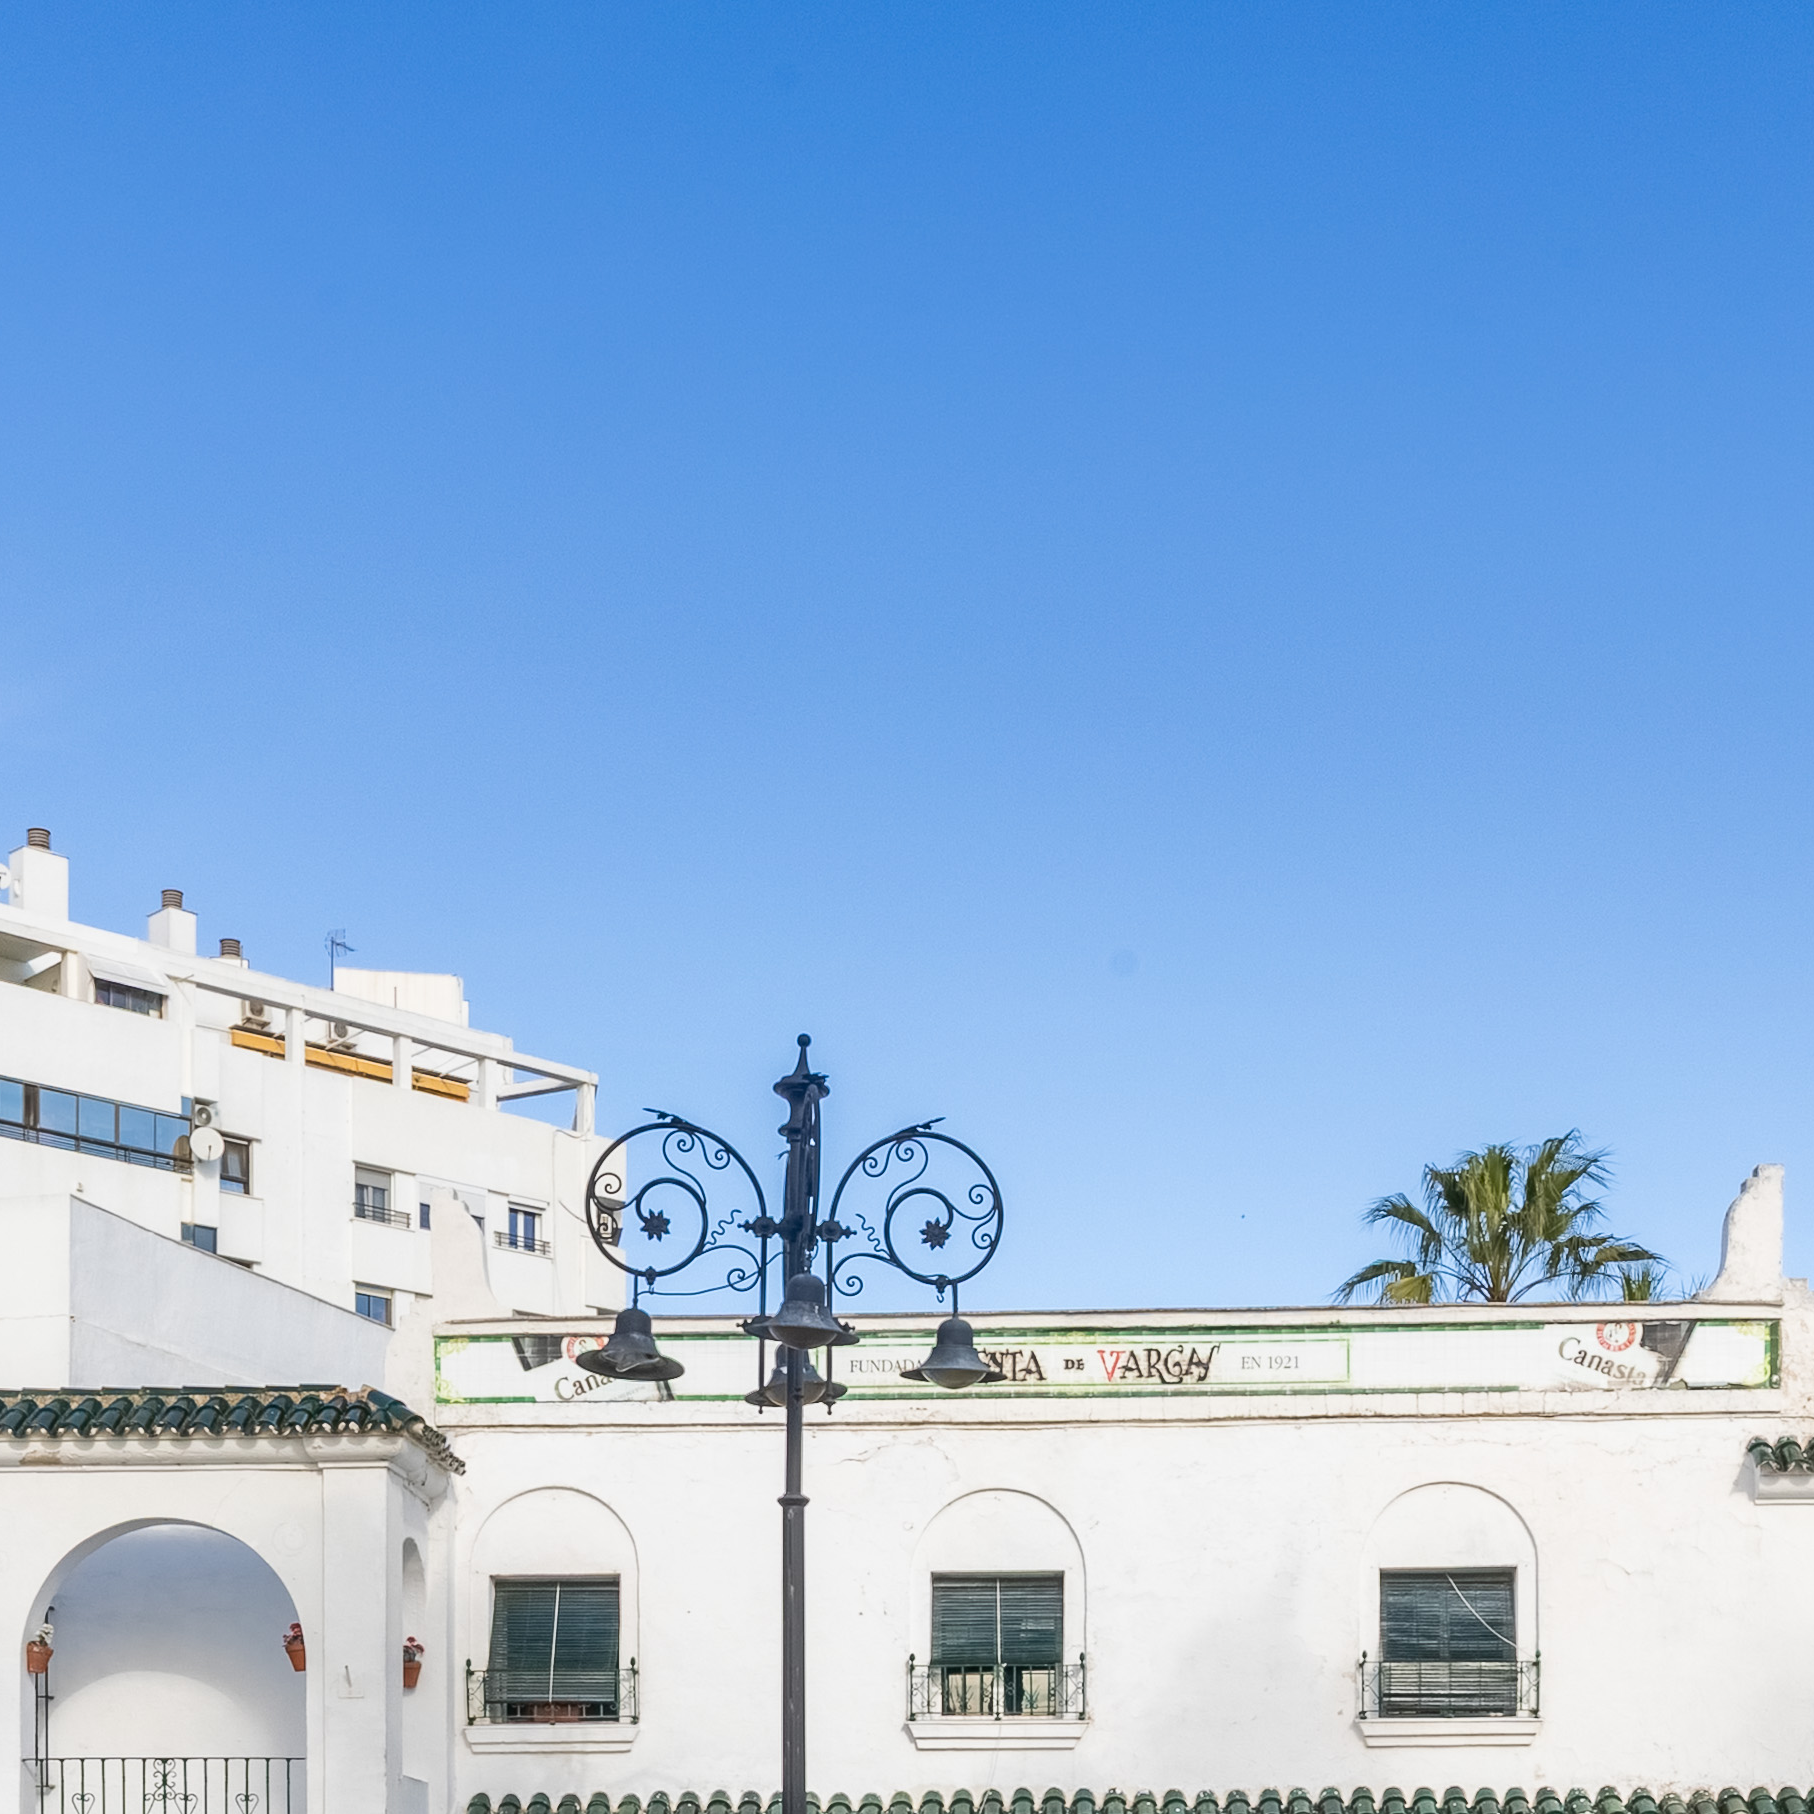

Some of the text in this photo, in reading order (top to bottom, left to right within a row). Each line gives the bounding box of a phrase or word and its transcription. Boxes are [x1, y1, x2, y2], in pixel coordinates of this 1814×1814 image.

[977, 1348, 1047, 1382] NTA
[1064, 1359, 1084, 1371] DE
[1097, 1343, 1221, 1384] VARGAS
[1241, 1356, 1262, 1370] EN
[1268, 1356, 1299, 1370] 1921
[1558, 1337, 1646, 1386] Canasta
[554, 1375, 616, 1401] Cana
